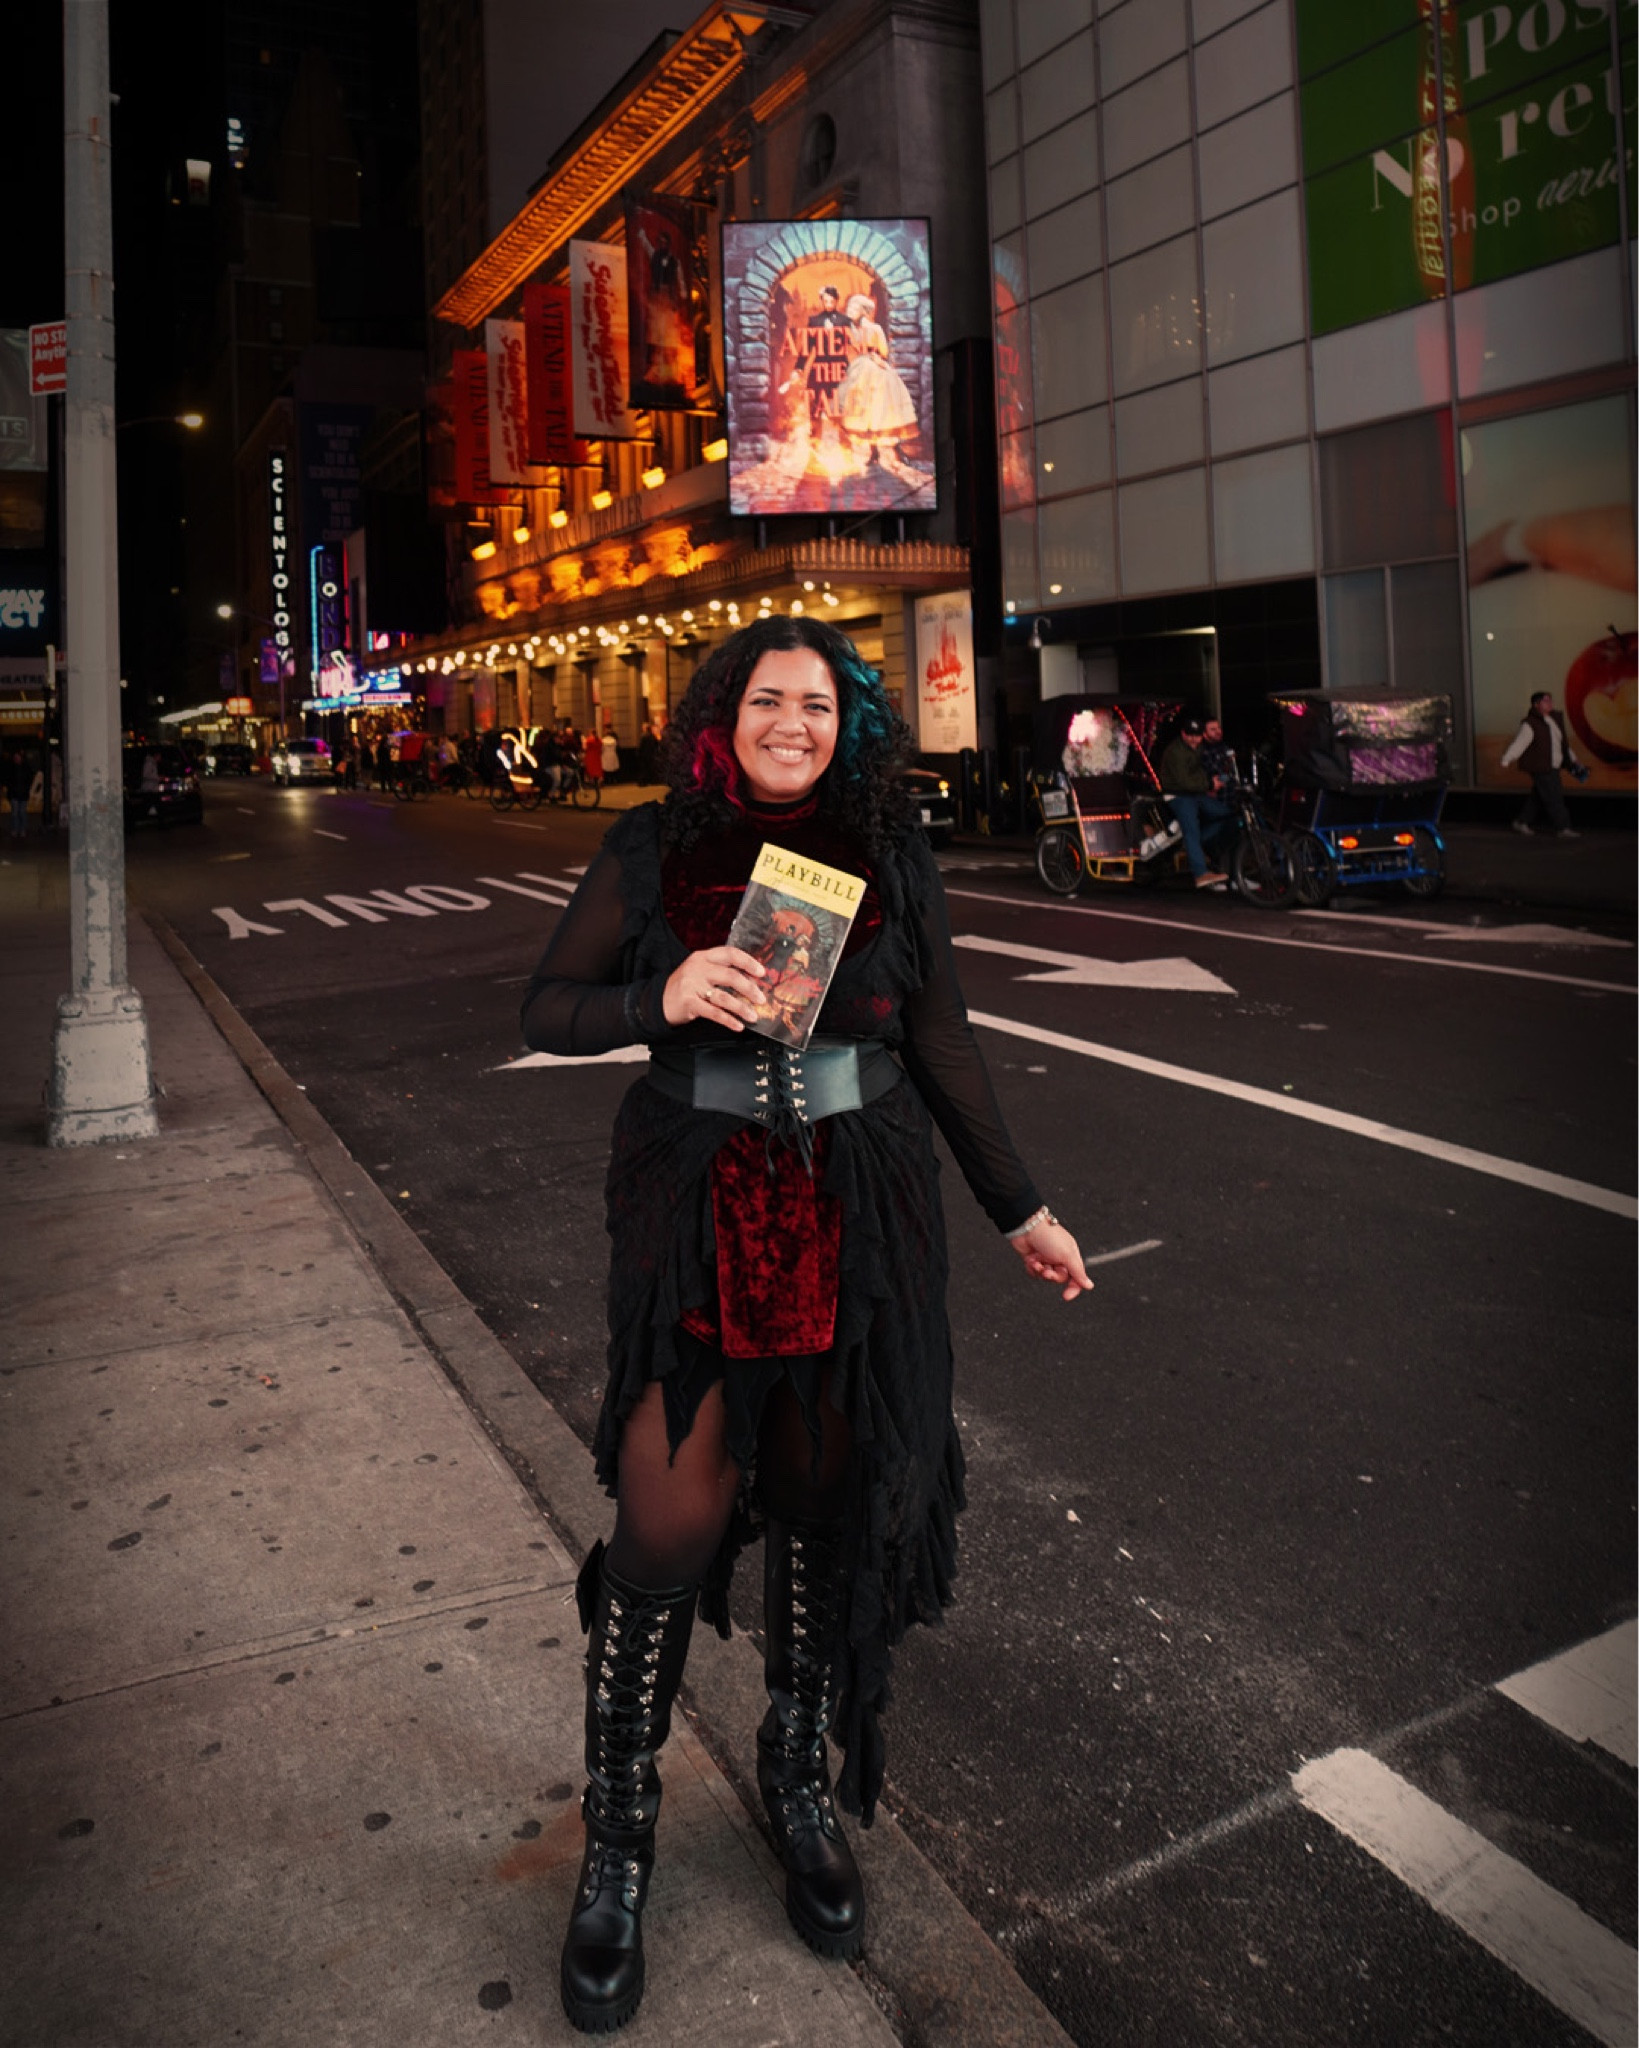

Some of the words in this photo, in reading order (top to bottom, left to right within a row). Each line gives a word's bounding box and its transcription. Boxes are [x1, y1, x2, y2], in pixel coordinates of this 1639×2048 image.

[1463, 0, 1636, 82] Pos
[34, 331, 49, 347] NO
[50, 328, 66, 344] ST
[35, 344, 66, 362] Anyti
[542, 299, 565, 374] ATTEND
[779, 327, 876, 357] ATTEN
[813, 361, 848, 383] THE
[800, 388, 856, 418] TAL
[546, 404, 569, 458] TALE
[271, 457, 291, 662] SCIENTOLOGY
[0, 604, 45, 629] CT
[762, 852, 857, 902] PLAYBILL
[211, 883, 492, 940] ONLY
